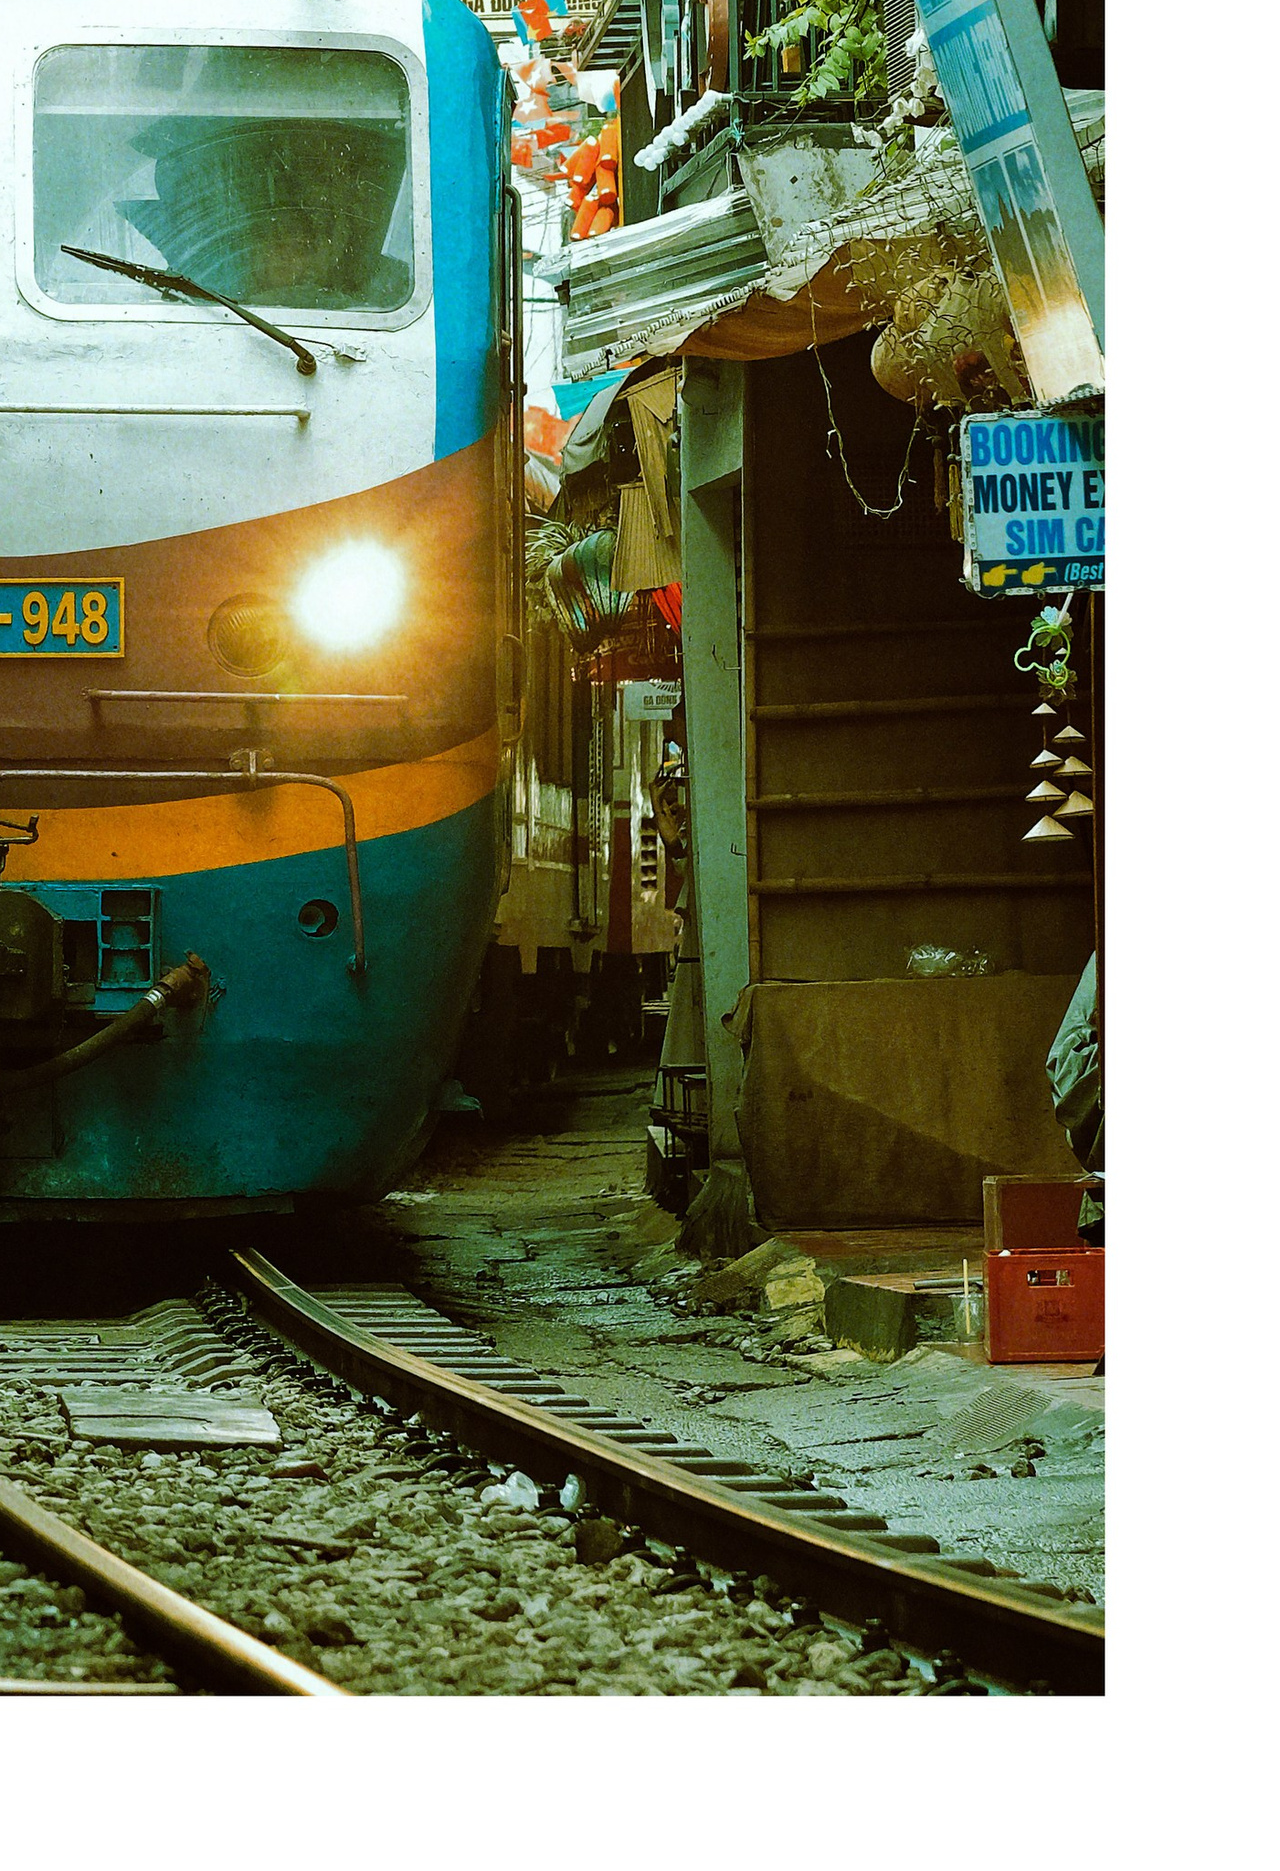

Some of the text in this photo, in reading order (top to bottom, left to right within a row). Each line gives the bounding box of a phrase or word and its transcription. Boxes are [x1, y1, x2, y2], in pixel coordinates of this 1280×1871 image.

[970, 420, 1105, 467] BOOKING
[972, 469, 1105, 515] MONEY E
[1005, 518, 1065, 556] SIM
[1064, 561, 1105, 583] (Best
